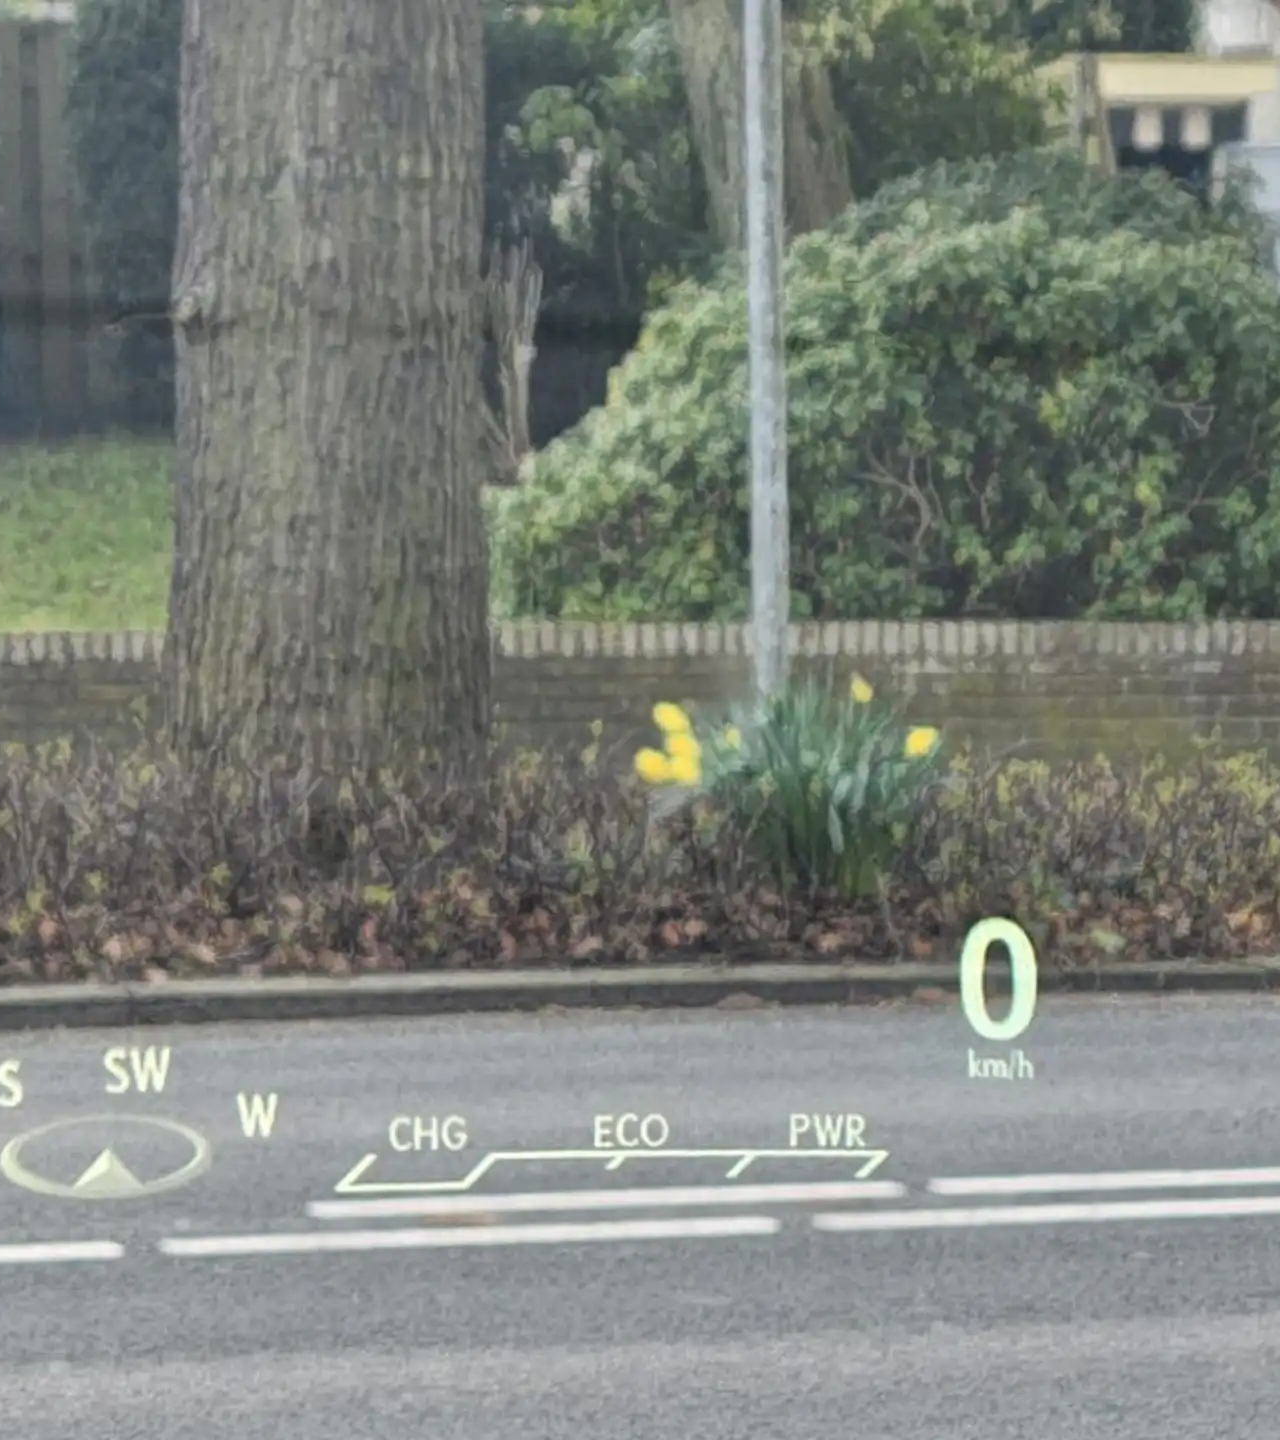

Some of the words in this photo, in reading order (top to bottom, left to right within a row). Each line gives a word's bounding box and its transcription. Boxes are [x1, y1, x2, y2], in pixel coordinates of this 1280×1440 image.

[960, 916, 1038, 1041] 0
[103, 1045, 171, 1093] SW
[236, 1091, 278, 1138] W
[968, 1047, 1034, 1081] km/h
[388, 1115, 469, 1150] CHG
[593, 1113, 670, 1148] ECO
[789, 1113, 867, 1148] PWR
